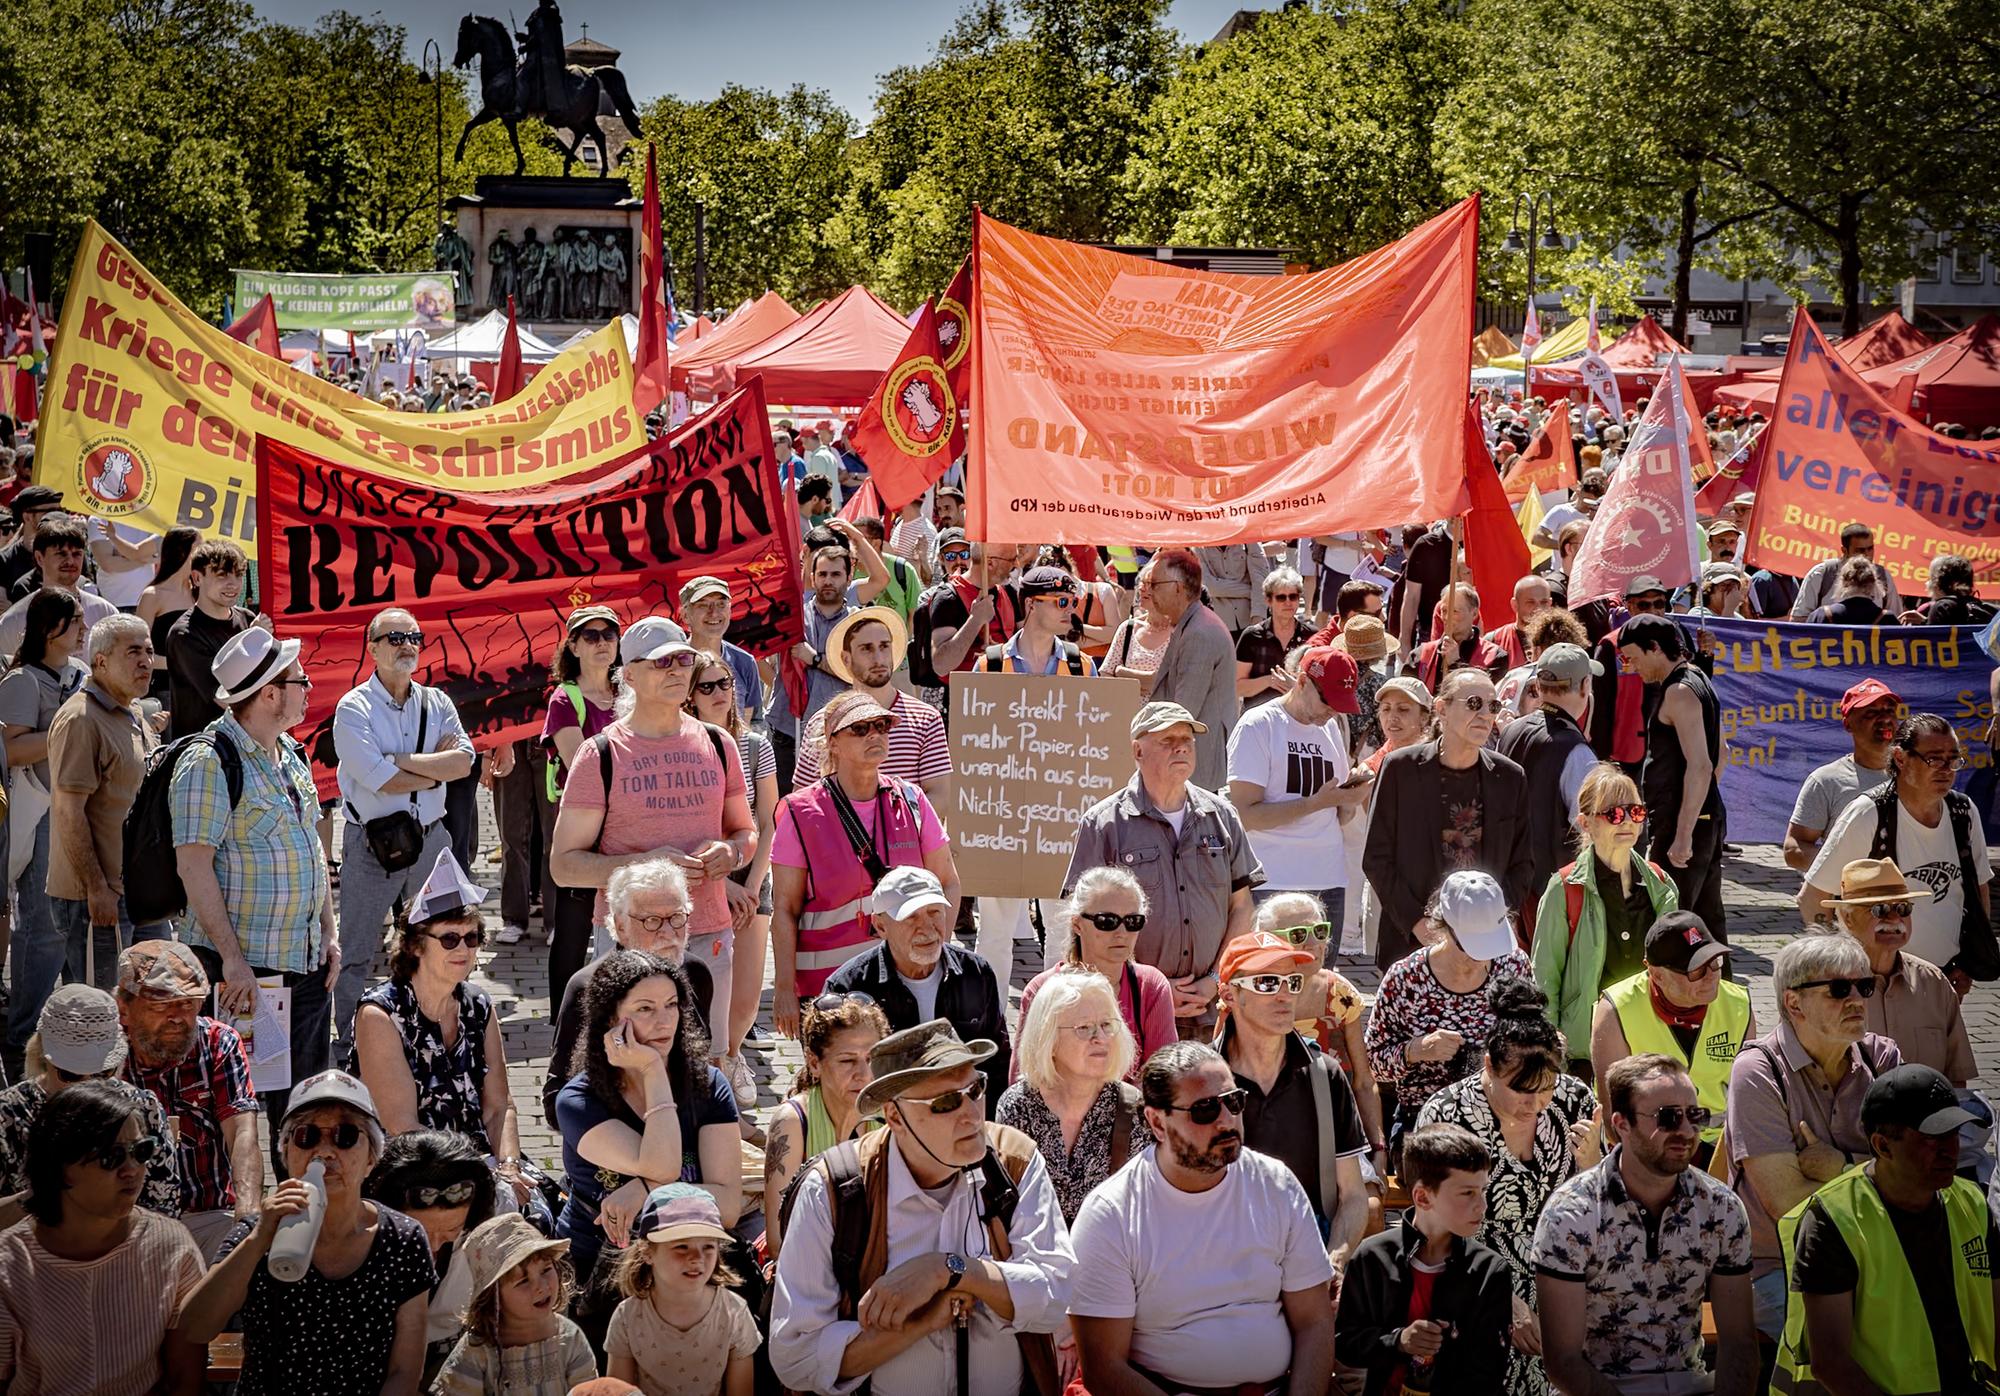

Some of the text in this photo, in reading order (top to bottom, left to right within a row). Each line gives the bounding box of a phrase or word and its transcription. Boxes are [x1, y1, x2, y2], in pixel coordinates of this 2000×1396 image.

[243, 281, 398, 296] EIN KLUGER KOPF PASST
[288, 300, 332, 312] KEINEN
[338, 299, 412, 312] STAHLHELM.
[79, 296, 233, 397] Kriege
[61, 363, 143, 429] für
[1477, 377, 1495, 385] CDU
[1786, 389, 1907, 444] aller
[296, 464, 457, 519] UNSER
[283, 456, 773, 615] REVOLUTION
[1713, 626, 1960, 676] eutschland
[962, 687, 1112, 728] Ihr streikt für
[961, 721, 1110, 762] mehr Papier, das
[1287, 741, 1323, 756] BLACK
[632, 751, 703, 771] DRY GOODS
[960, 754, 1113, 790] unendlich aus dem
[620, 770, 719, 794] TOM TAILOR
[645, 792, 705, 809] MCMLXII
[959, 786, 1013, 819] Nichts
[960, 824, 1028, 854] werden
[1915, 861, 1962, 880] BLAC
[1707, 1032, 1728, 1046] TEAM
[1962, 1237, 1983, 1256] EAM
